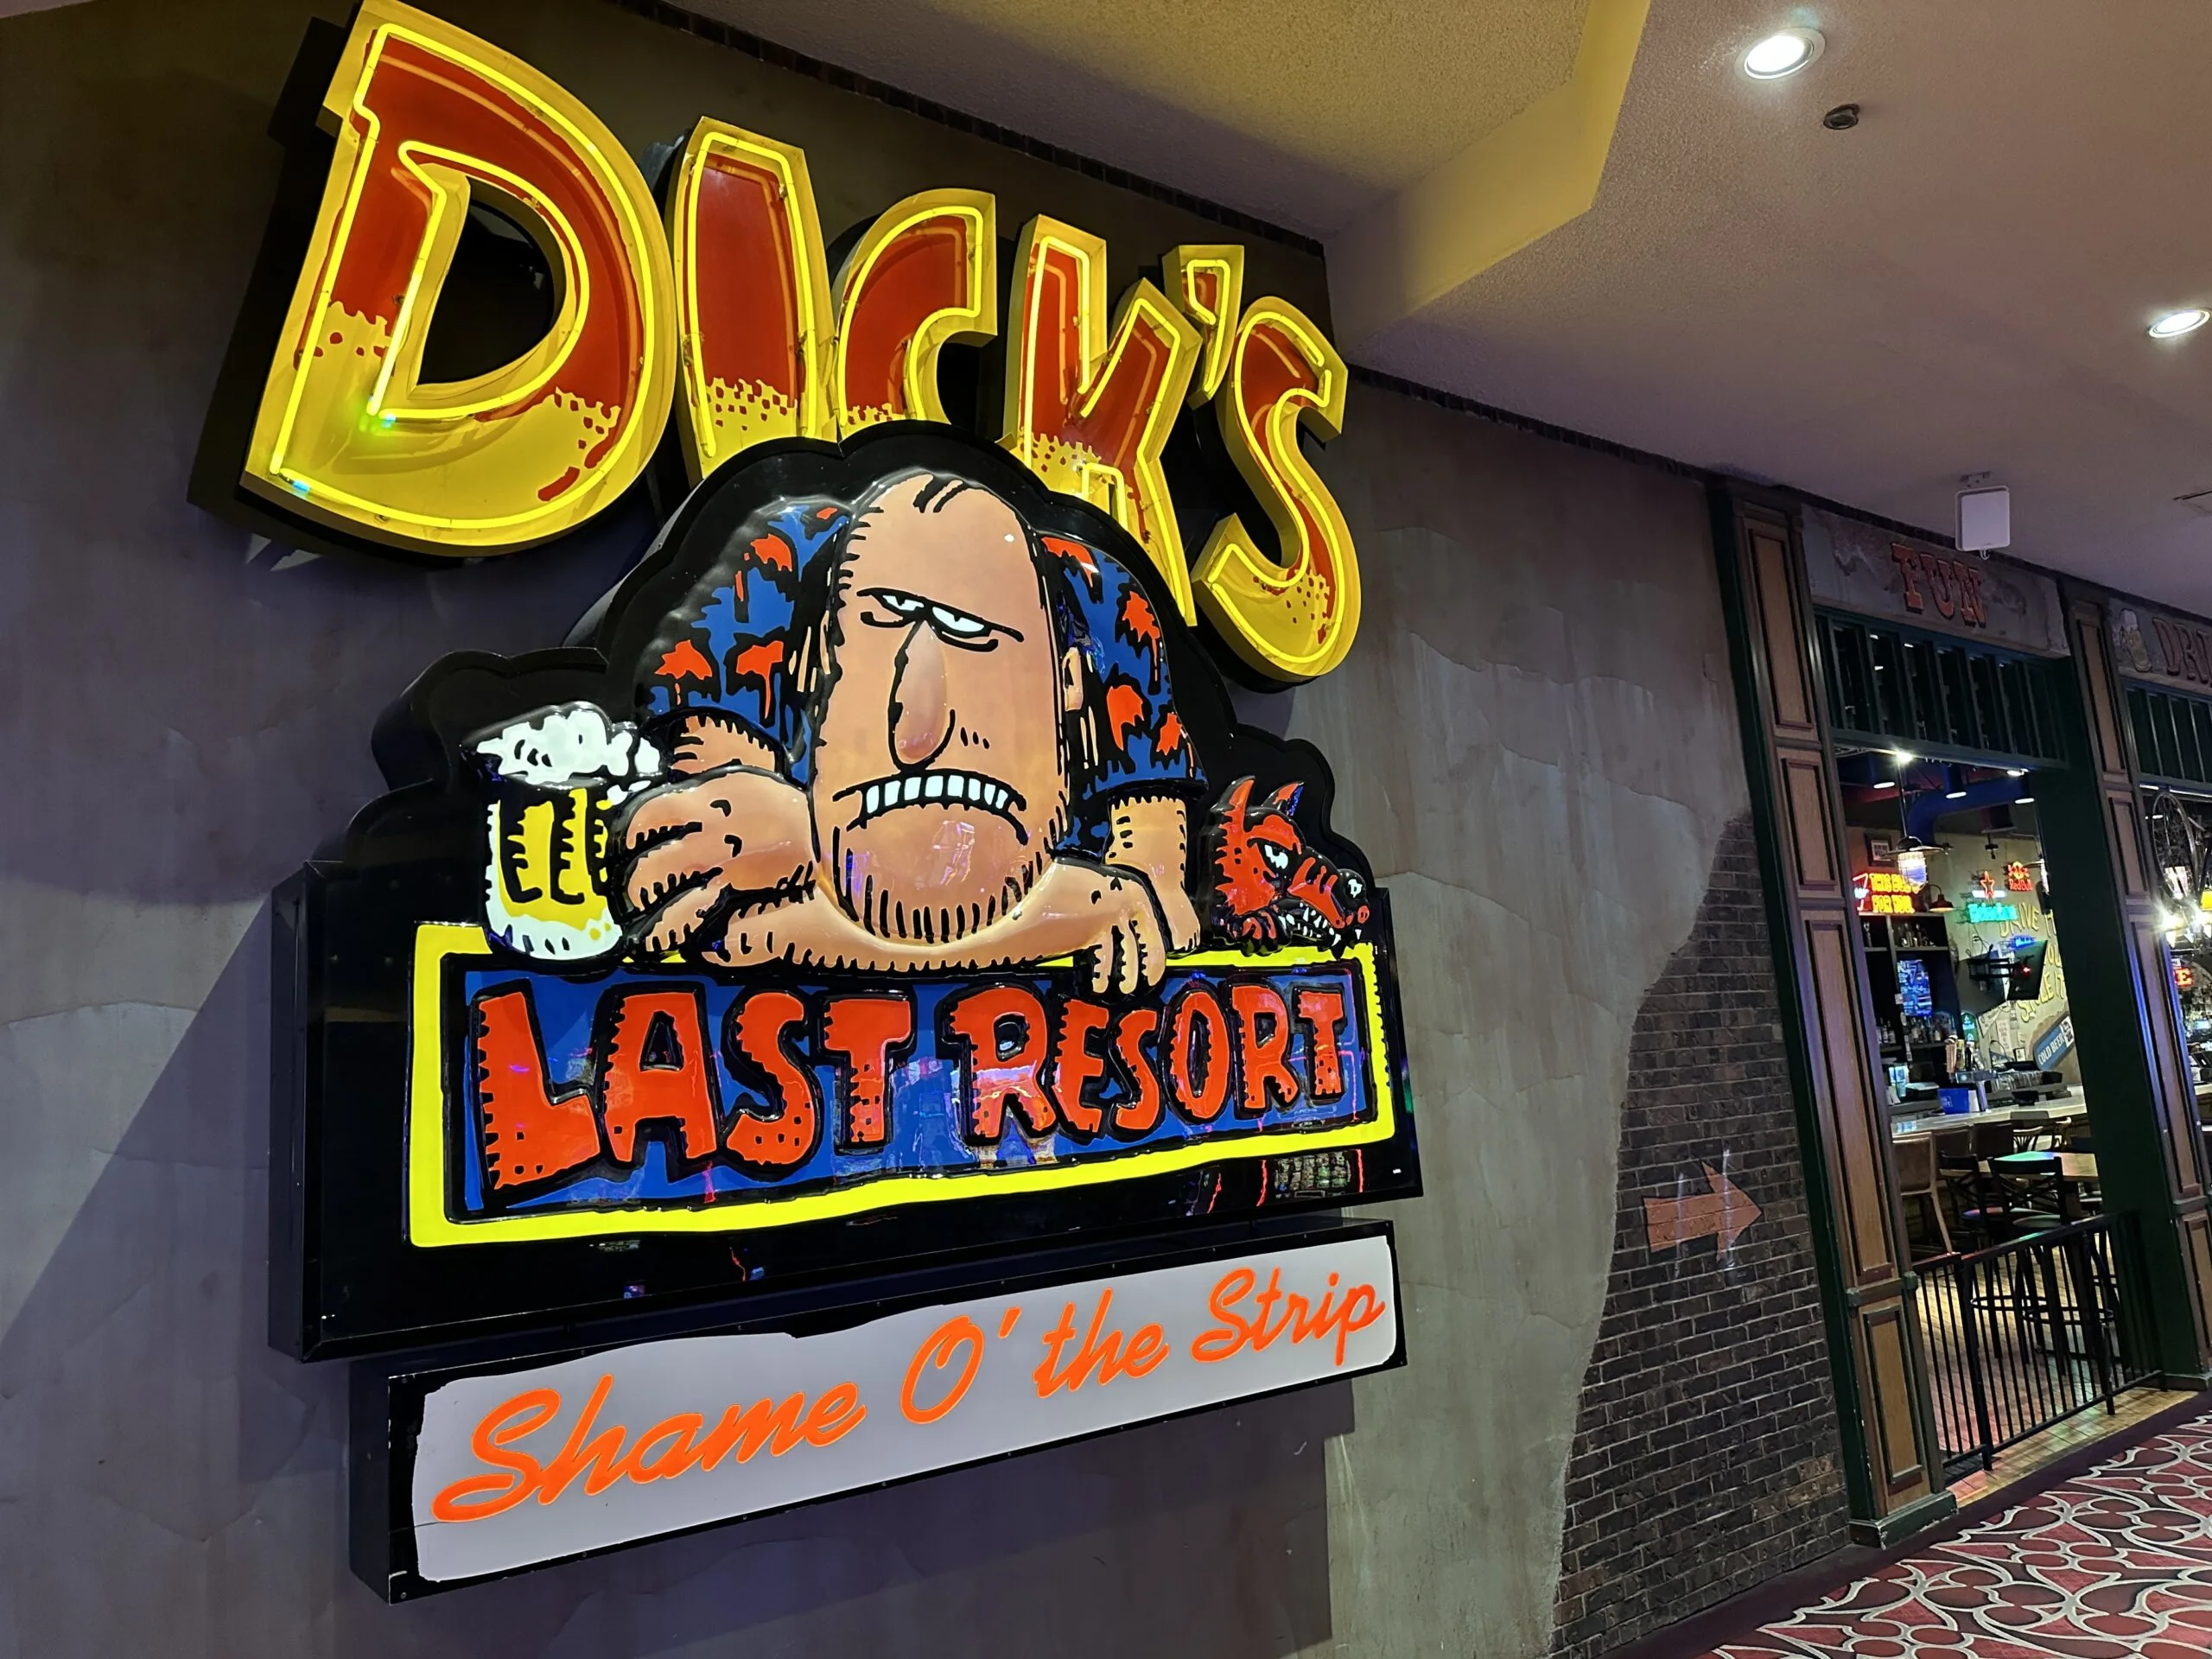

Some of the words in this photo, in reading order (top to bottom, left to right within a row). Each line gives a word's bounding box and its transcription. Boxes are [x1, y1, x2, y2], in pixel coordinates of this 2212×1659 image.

[245, 0, 1361, 683] DICK'S
[1891, 543, 1986, 626] FUN
[1872, 894, 1893, 913] FOR
[2047, 943, 2063, 968] OU
[477, 989, 912, 1191] LAST
[950, 984, 1344, 1139] RESORT
[2037, 1045, 2052, 1065] COLD
[2050, 1033, 2065, 1053] BEER
[430, 1372, 868, 1523] Shame
[899, 1306, 1022, 1425] O'
[1033, 1287, 1171, 1399] the
[1190, 1267, 1386, 1367] Strip
